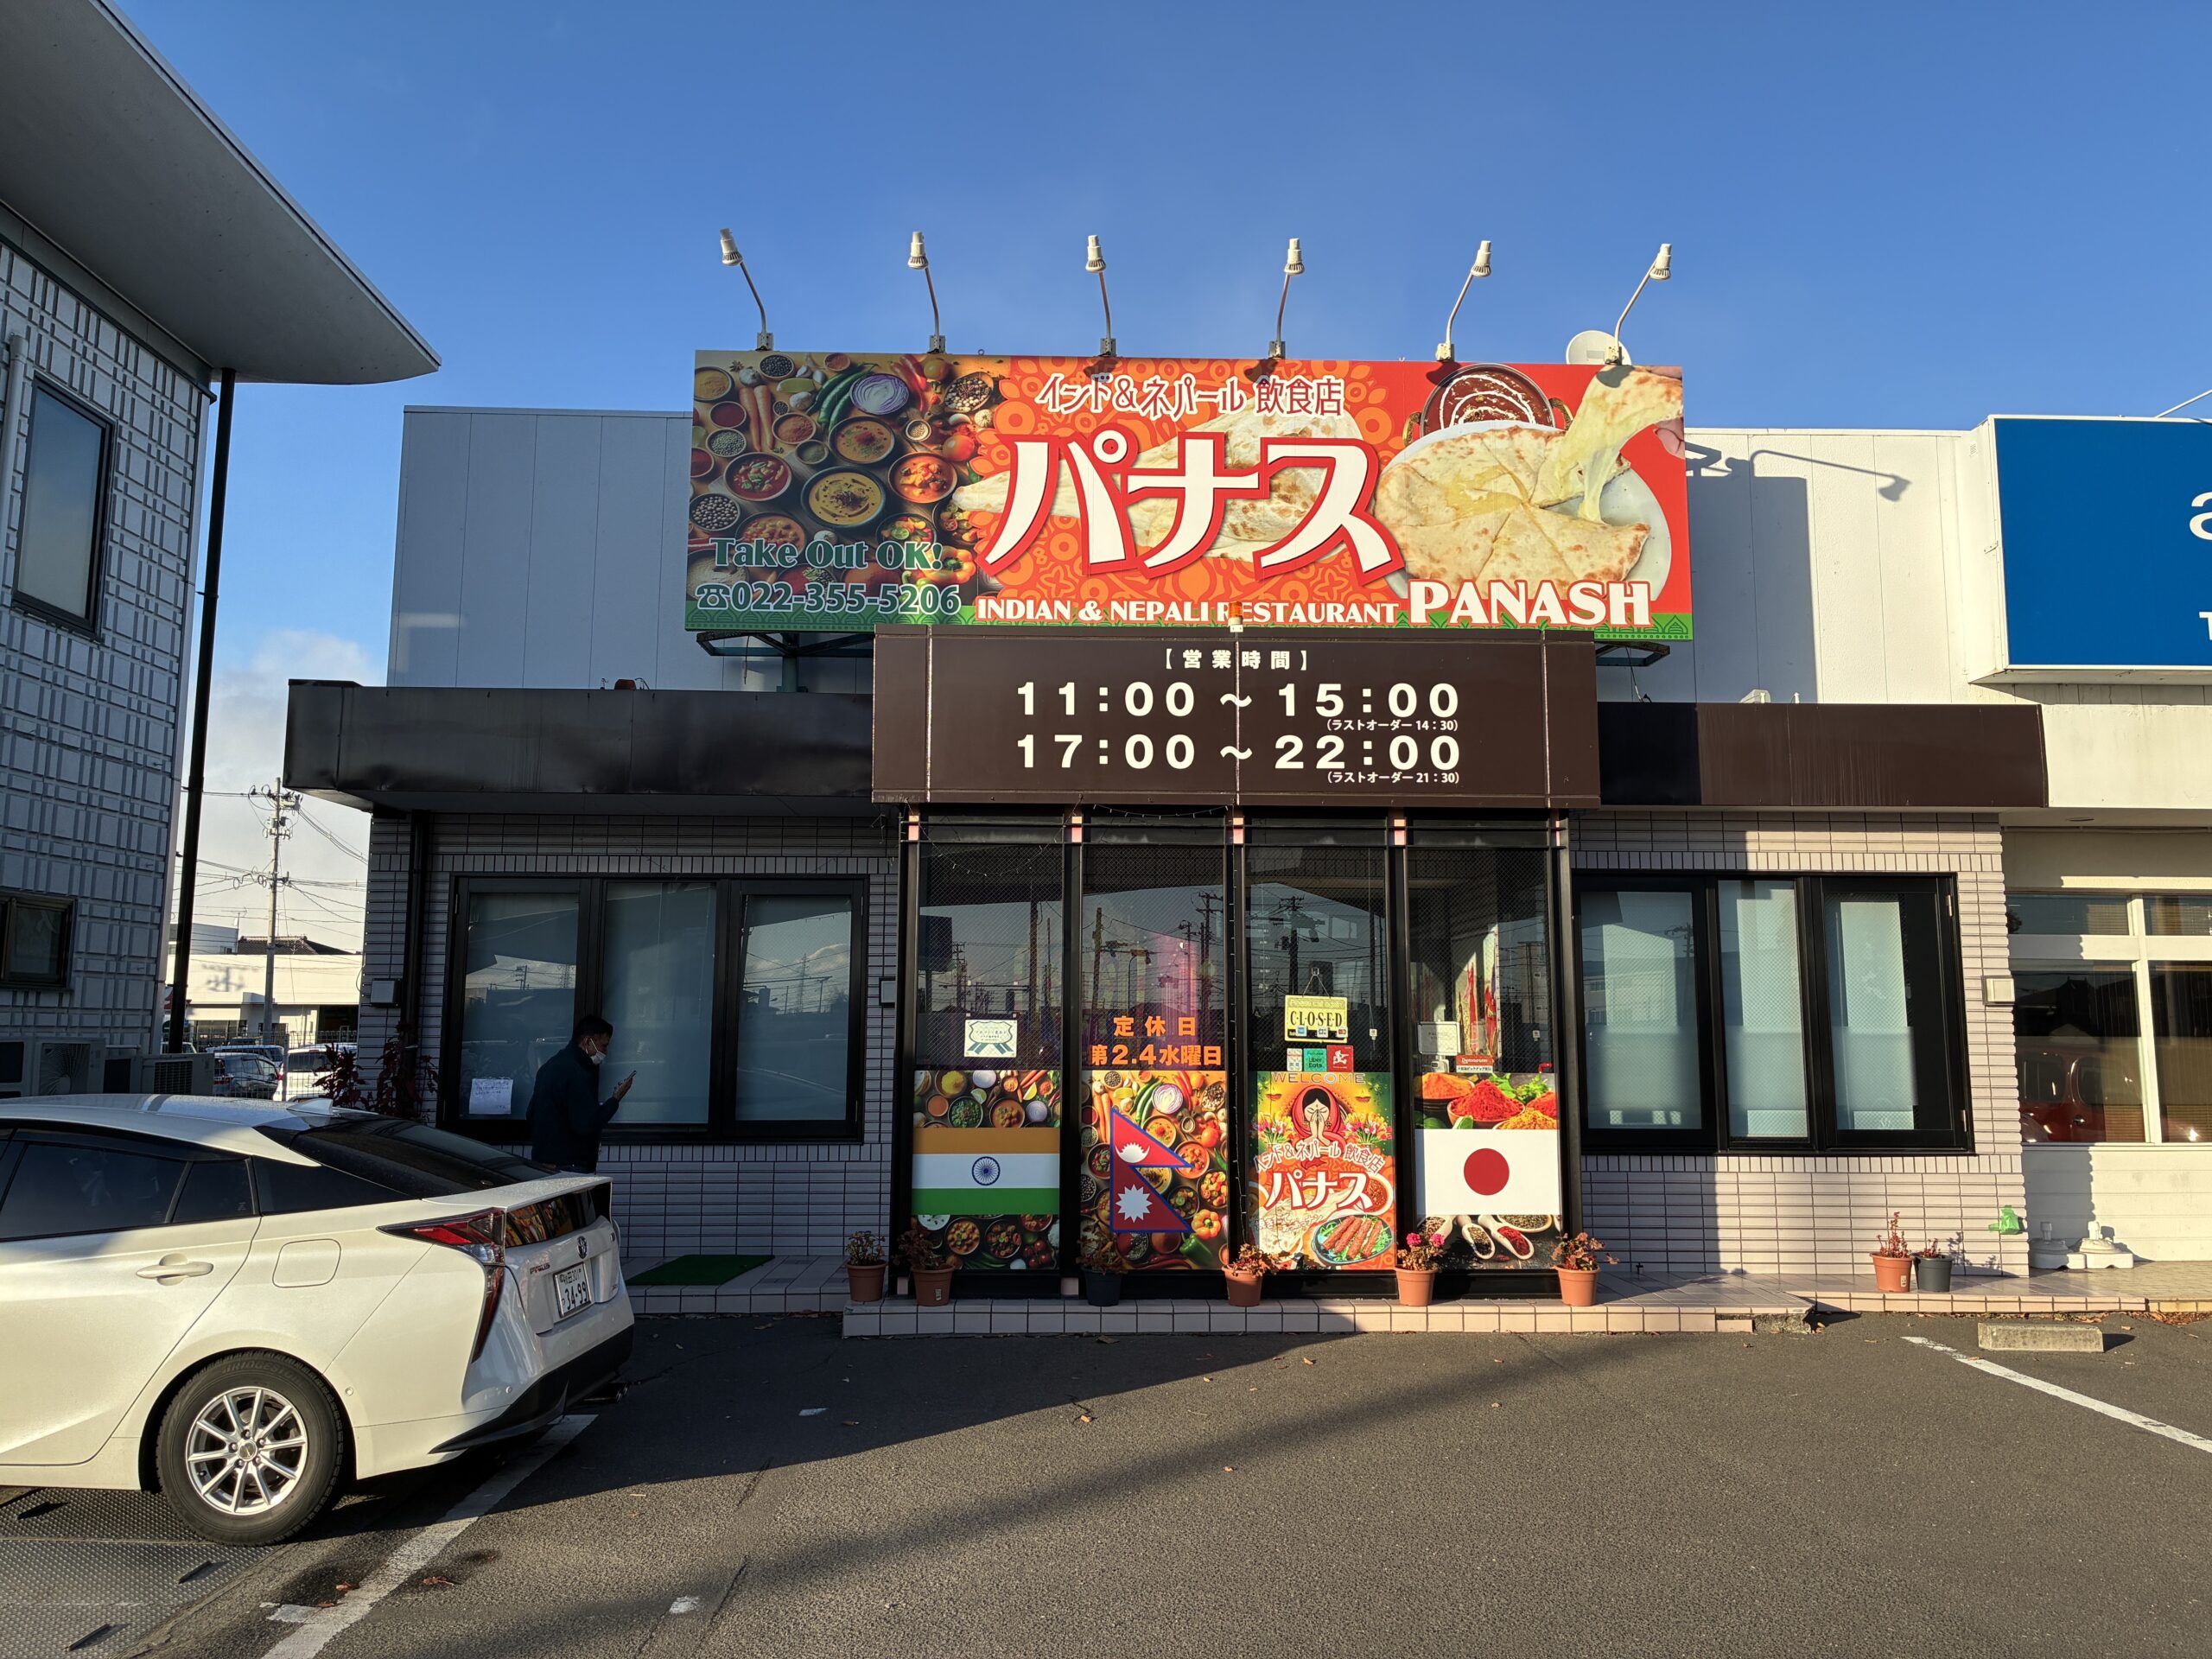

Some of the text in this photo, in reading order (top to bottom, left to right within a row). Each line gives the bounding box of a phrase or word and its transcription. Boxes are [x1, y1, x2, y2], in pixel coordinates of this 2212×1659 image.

[1255, 375, 1344, 417] 飲食店
[982, 427, 1401, 578] パナス
[709, 537, 944, 569] Take Out OK!
[730, 582, 962, 615] 022-355-5206
[977, 598, 1399, 623] INDIAN & NEPALI RESTAURANT
[1409, 580, 1652, 626] PANASH
[1017, 681, 1195, 717] 11:00
[1278, 683, 1459, 718] 15:00
[1017, 734, 1195, 770] 17:00
[1274, 734, 1459, 770] 22:00
[1113, 1015, 1196, 1037] 定休日
[1271, 1072, 1366, 1084] WELCOME
[1344, 1142, 1386, 1174] 飲食店
[1264, 1169, 1374, 1211] パナス
